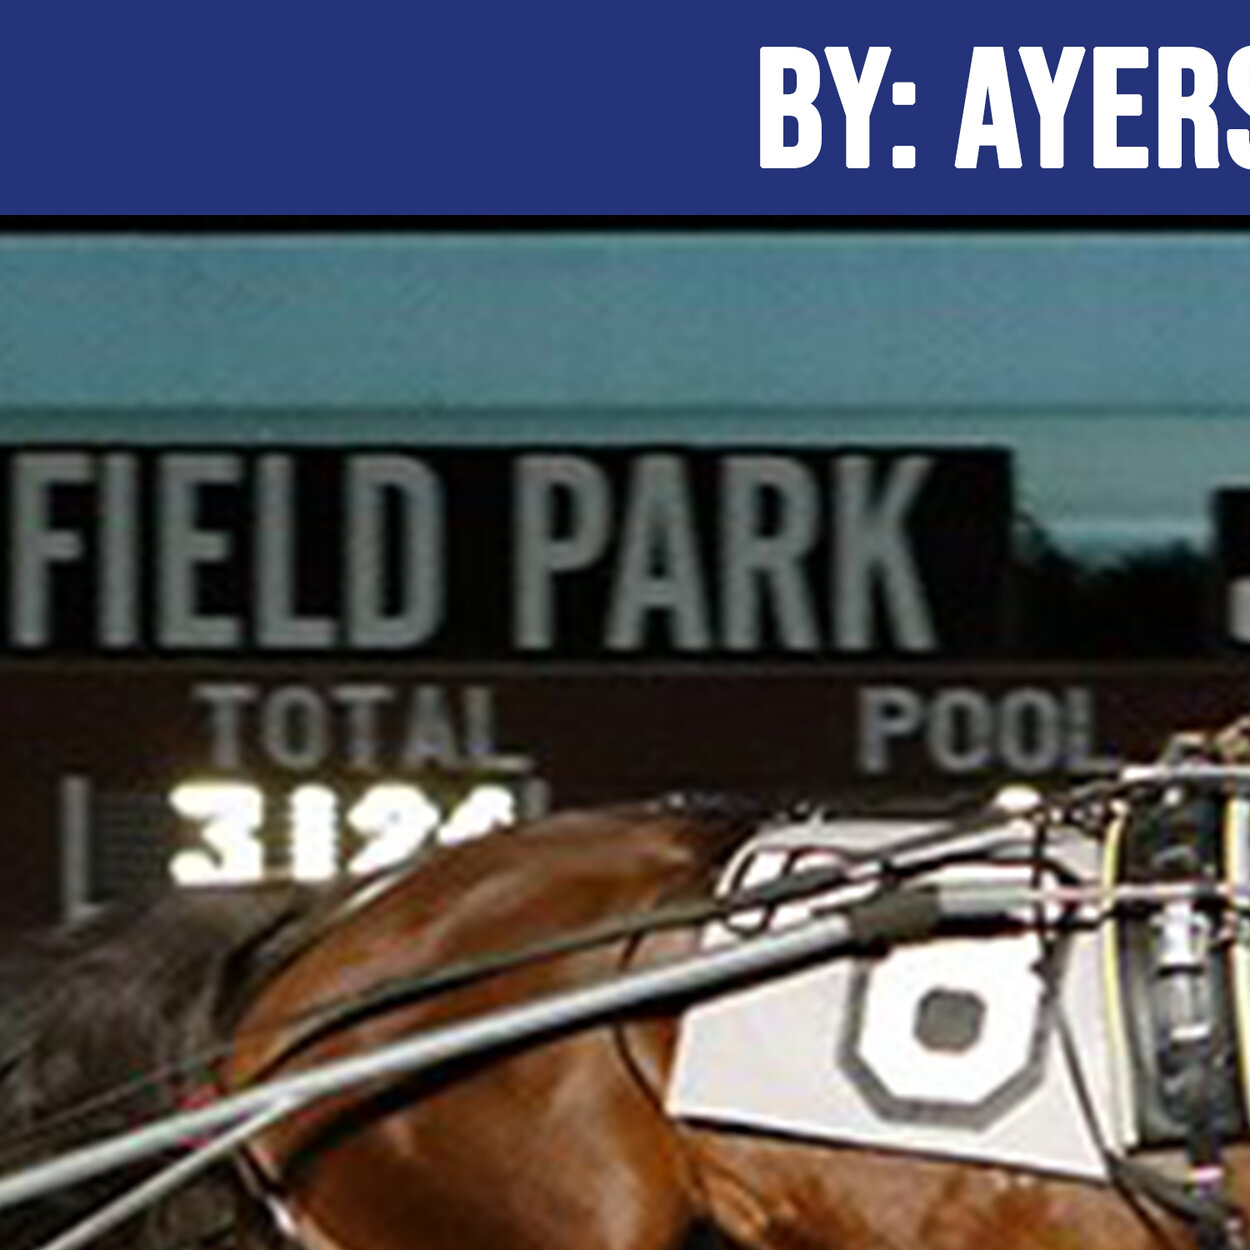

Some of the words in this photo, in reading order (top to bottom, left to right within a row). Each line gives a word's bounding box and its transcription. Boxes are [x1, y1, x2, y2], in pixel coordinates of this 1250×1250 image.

[10, 452, 443, 650] FIELD
[514, 454, 936, 653] PARK
[193, 684, 532, 770] TOTAL
[858, 686, 1116, 773] POOL
